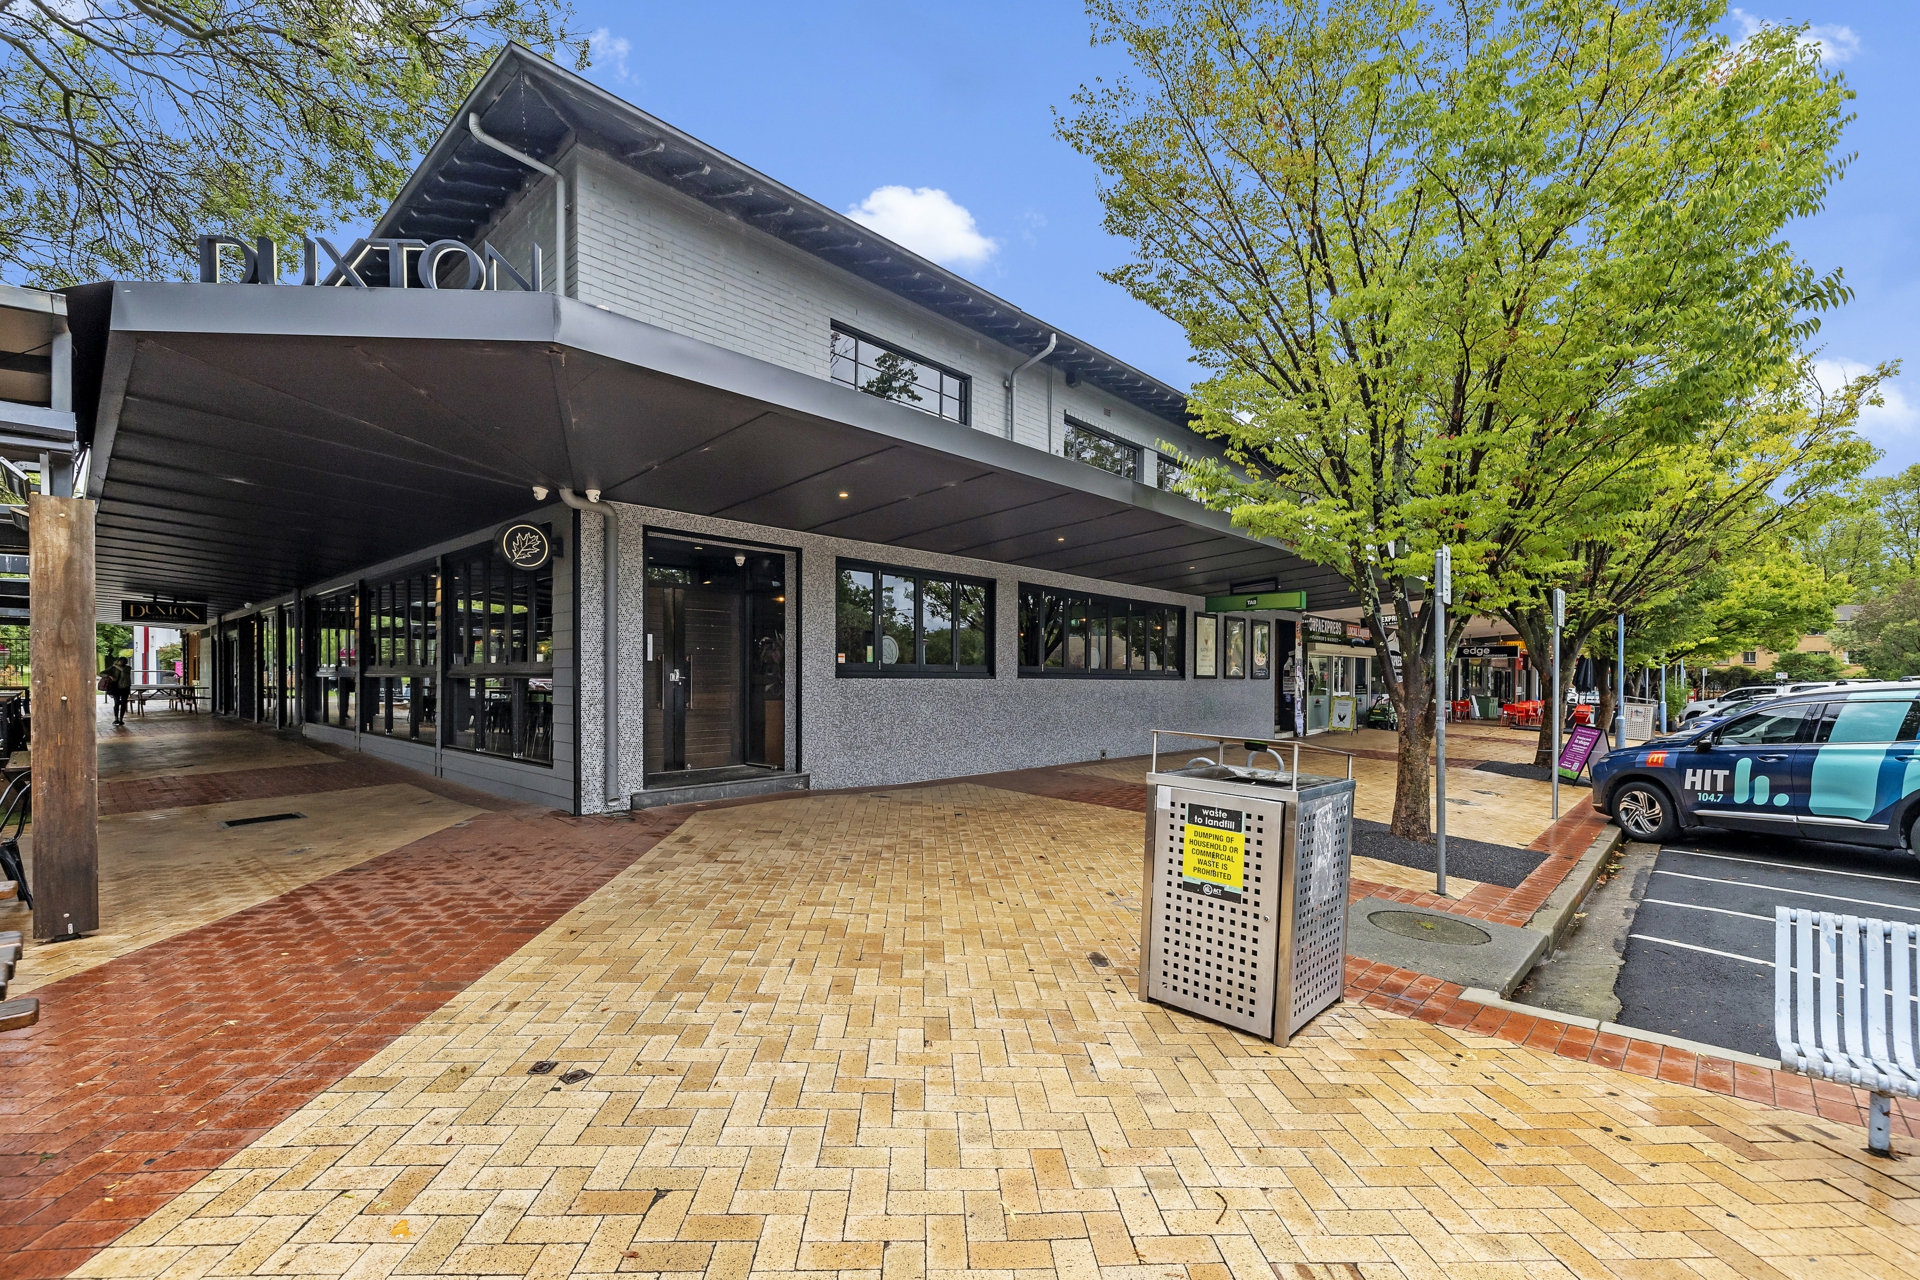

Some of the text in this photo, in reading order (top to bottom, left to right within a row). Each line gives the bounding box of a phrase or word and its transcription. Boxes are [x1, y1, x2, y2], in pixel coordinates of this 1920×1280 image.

[200, 234, 542, 292] DUXTON
[1347, 626, 1359, 637] LOCAL
[1463, 646, 1490, 656] edge
[1684, 768, 1730, 791] HIT
[1697, 792, 1723, 802] 104.7
[1202, 808, 1228, 818] waste
[1194, 815, 1235, 830] to landfill
[1193, 830, 1235, 844] DUMPING OF
[1189, 839, 1239, 854] HOUSEHOLD OR
[1191, 848, 1235, 863] COMMERCIAL
[1197, 858, 1228, 871] WASTE IS
[1193, 866, 1232, 880] PROHIBITED
